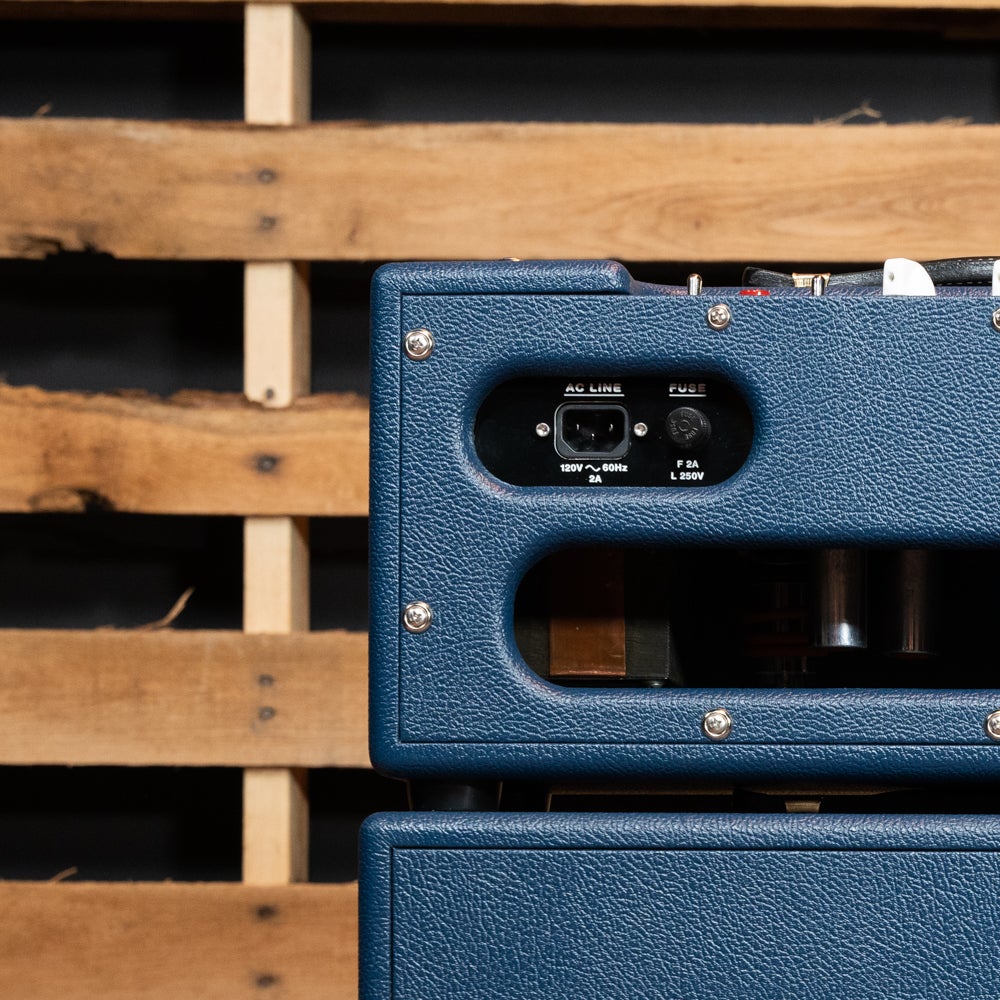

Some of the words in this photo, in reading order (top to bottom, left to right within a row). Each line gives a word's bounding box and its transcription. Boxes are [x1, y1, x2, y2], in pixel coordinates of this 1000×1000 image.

[565, 383, 585, 393] AC
[589, 383, 622, 393] LINE
[668, 383, 706, 393] FUSE
[560, 463, 583, 472] 120V
[602, 463, 628, 472] 60Hz
[676, 459, 684, 468] F
[685, 459, 699, 468] 2A
[588, 474, 602, 483] 2A
[670, 472, 678, 480] L
[679, 472, 704, 480] 250V
